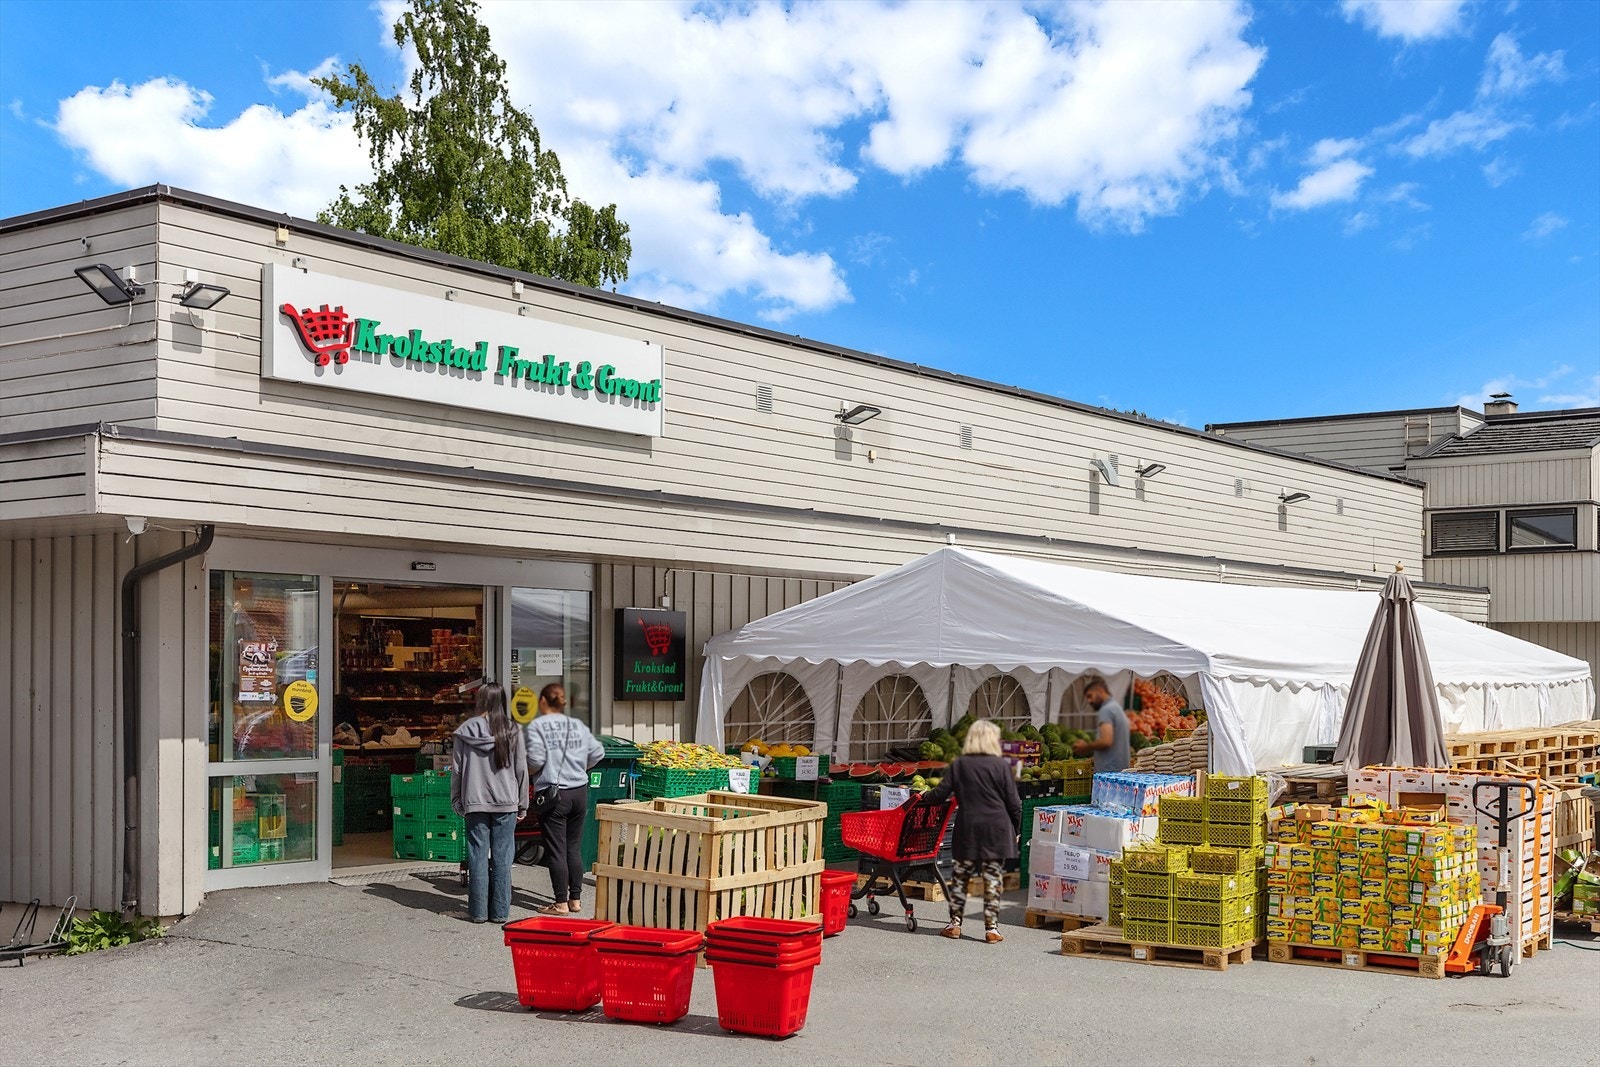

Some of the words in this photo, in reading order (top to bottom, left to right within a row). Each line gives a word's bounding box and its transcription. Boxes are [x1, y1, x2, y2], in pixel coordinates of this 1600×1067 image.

[353, 318, 489, 372] Krokstad
[499, 345, 571, 387] Frukt
[598, 365, 661, 402] Grønt
[634, 660, 677, 674] Krokstad
[625, 680, 684, 693] Frukt&Grønt
[1064, 850, 1081, 858] TILBUD
[1464, 912, 1480, 945] DOOSAN
